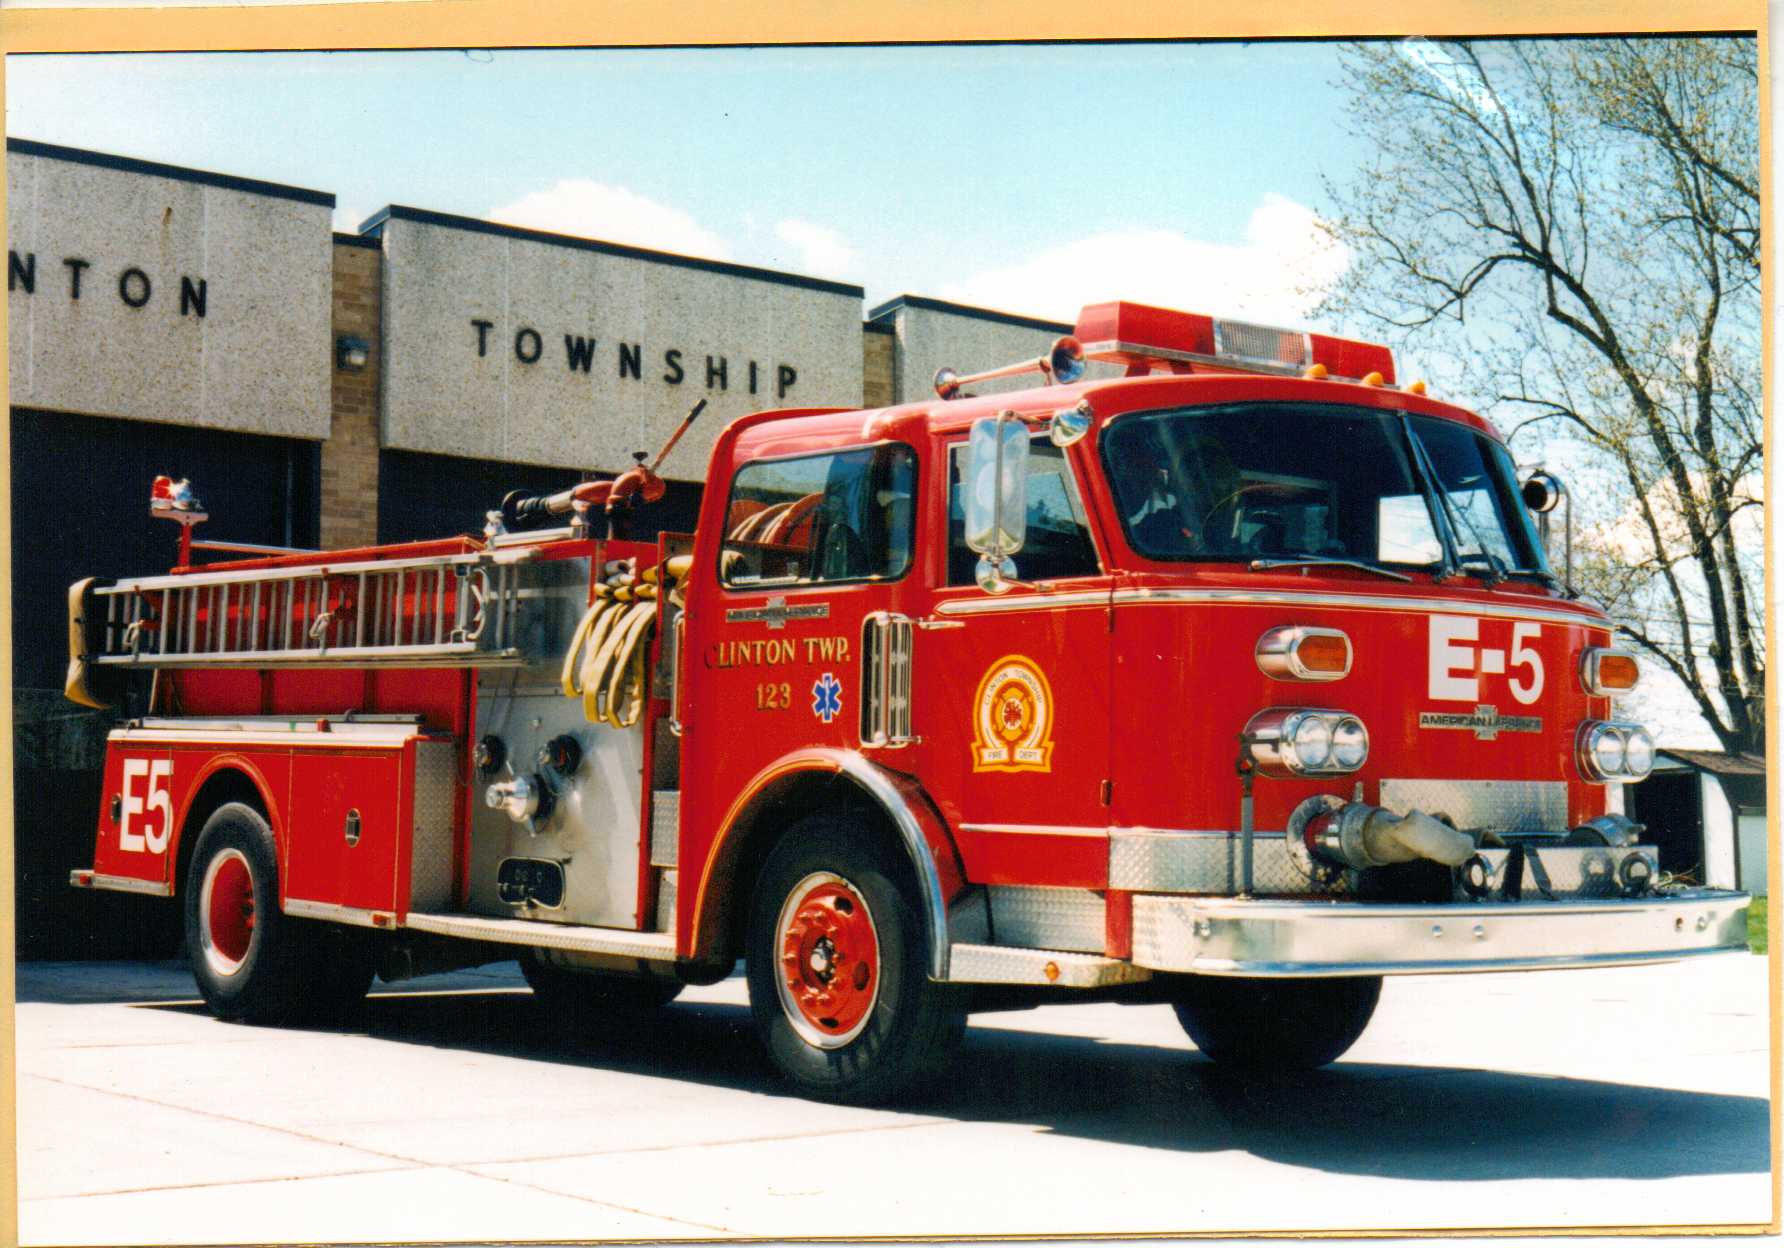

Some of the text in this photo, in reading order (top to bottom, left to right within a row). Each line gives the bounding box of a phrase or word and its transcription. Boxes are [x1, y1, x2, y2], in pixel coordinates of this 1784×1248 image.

[8, 250, 207, 318] NTON
[471, 319, 797, 398] TOWNSHIP
[803, 636, 851, 664] TWP.
[1429, 614, 1545, 705] E-5
[757, 683, 791, 711] 123
[120, 758, 174, 854] E5
